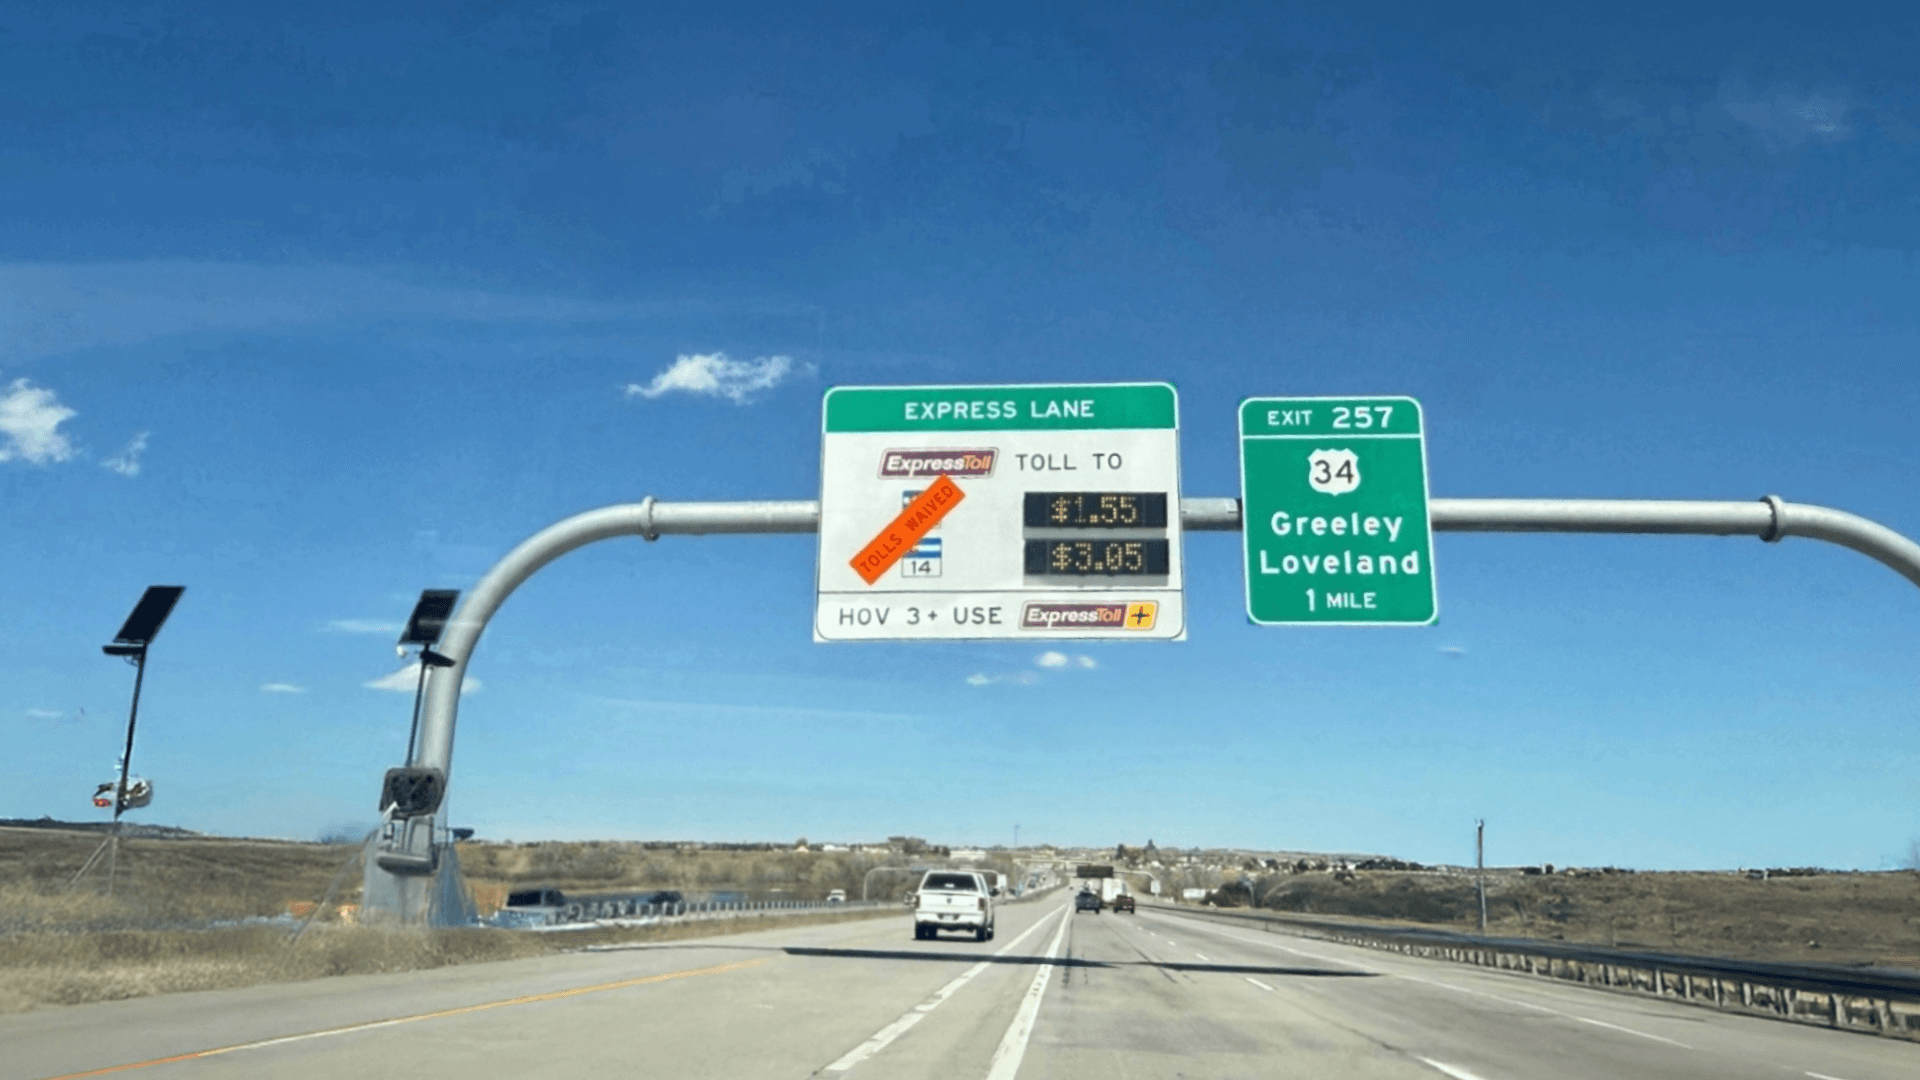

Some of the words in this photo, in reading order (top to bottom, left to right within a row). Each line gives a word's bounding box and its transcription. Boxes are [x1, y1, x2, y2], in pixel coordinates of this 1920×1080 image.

[905, 401, 1017, 420] EXPRESS
[1030, 400, 1095, 418] LANE
[1267, 410, 1313, 426] EXIT
[1332, 406, 1393, 429] 257
[886, 454, 992, 478] ExpressToll
[1015, 453, 1077, 471] TOLL
[1092, 453, 1122, 470] TO
[1314, 459, 1354, 485] 34
[1051, 496, 1137, 523] $1.55
[859, 533, 903, 573] TOLLS
[904, 485, 954, 532] WAIVED
[1270, 511, 1403, 543] Greeley
[911, 560, 931, 575] 14
[1052, 543, 1142, 570] $3.05
[1260, 549, 1420, 575] Loveland
[1305, 588, 1316, 612] 1
[1326, 592, 1377, 609] MILE
[839, 607, 890, 626] HOV
[953, 606, 1003, 625] USE
[1027, 607, 1122, 629] ExpressToll
